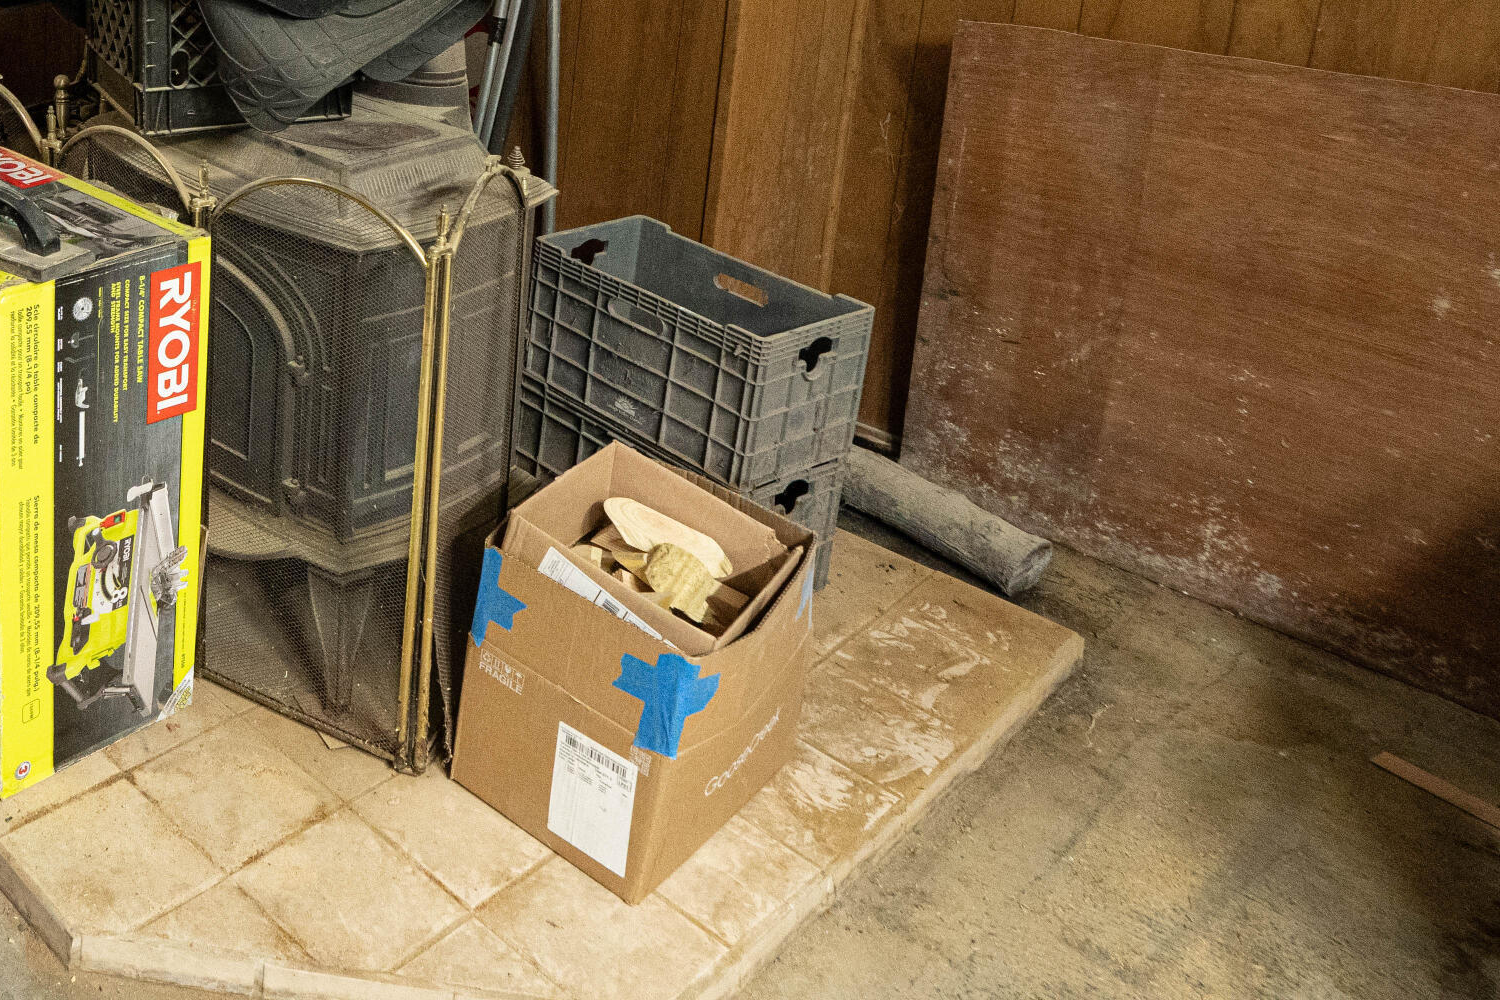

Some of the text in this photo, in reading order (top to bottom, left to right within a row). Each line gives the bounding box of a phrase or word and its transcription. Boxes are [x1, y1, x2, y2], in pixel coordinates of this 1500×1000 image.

[137, 299, 145, 338] COMPACT
[26, 337, 33, 352] mm
[136, 339, 144, 364] TABLE
[156, 271, 192, 414] RYOBI
[33, 434, 40, 444] de
[33, 521, 40, 531] de
[123, 537, 132, 562] RYOBI
[33, 594, 40, 602] de
[33, 632, 40, 645] mm
[478, 661, 523, 696] FRAGILE
